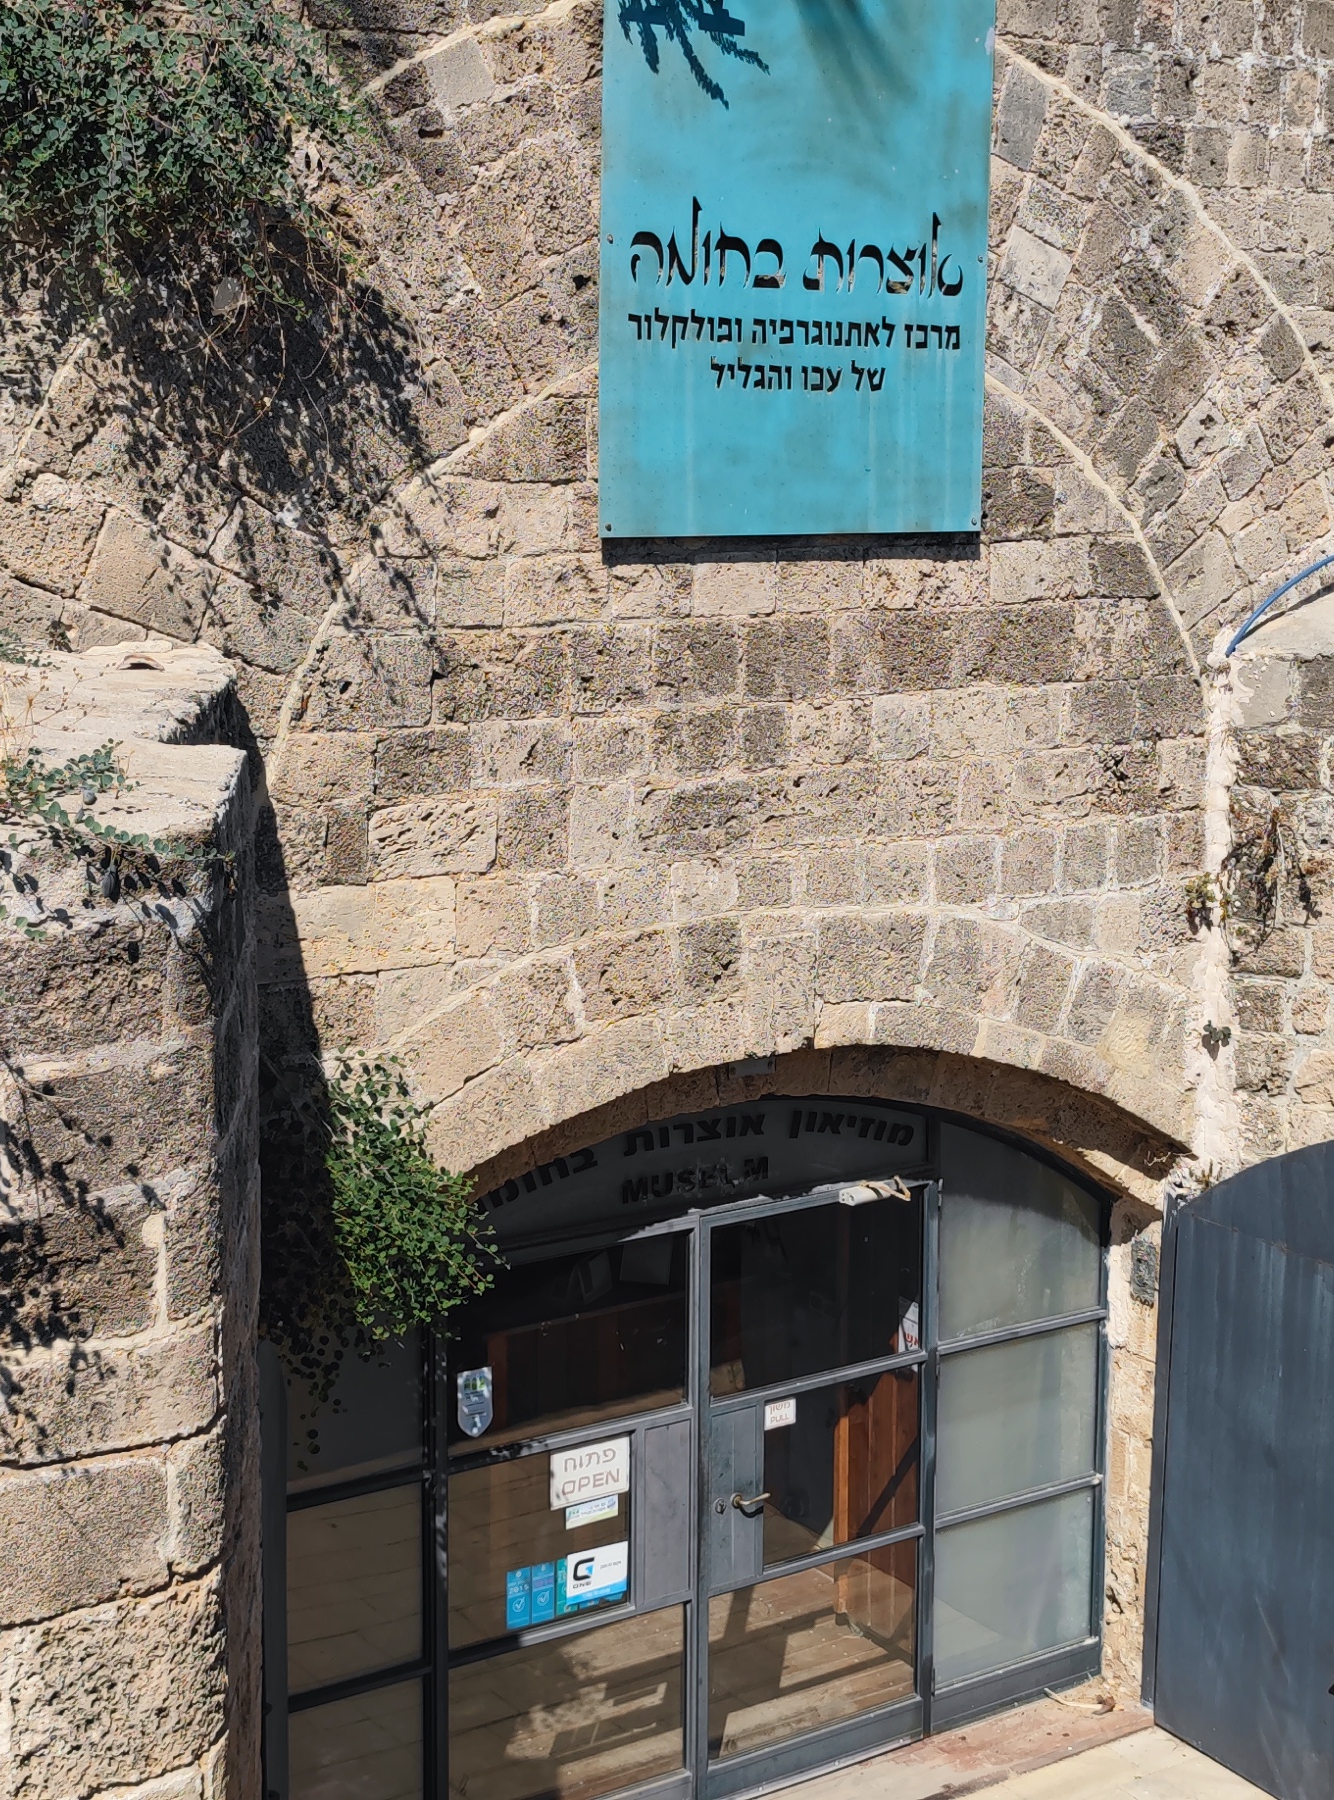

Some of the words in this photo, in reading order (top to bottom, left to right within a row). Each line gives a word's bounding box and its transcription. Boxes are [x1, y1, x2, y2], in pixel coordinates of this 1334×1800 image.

[630, 196, 788, 290] בחומה
[802, 212, 964, 300] אוצרות
[628, 307, 743, 349] ופולקלור
[751, 316, 896, 349] לאתנוגרפיה
[904, 324, 961, 350] מרכז
[710, 356, 792, 391] והגליל
[801, 364, 843, 393] עכו
[851, 360, 886, 392] של
[622, 1113, 766, 1157] אוצרות
[788, 1110, 915, 1147] מוזיאון
[769, 1401, 791, 1415] משוך
[770, 1413, 789, 1425] PULL
[564, 1447, 617, 1473] פתוח
[561, 1467, 620, 1496] OPEN
